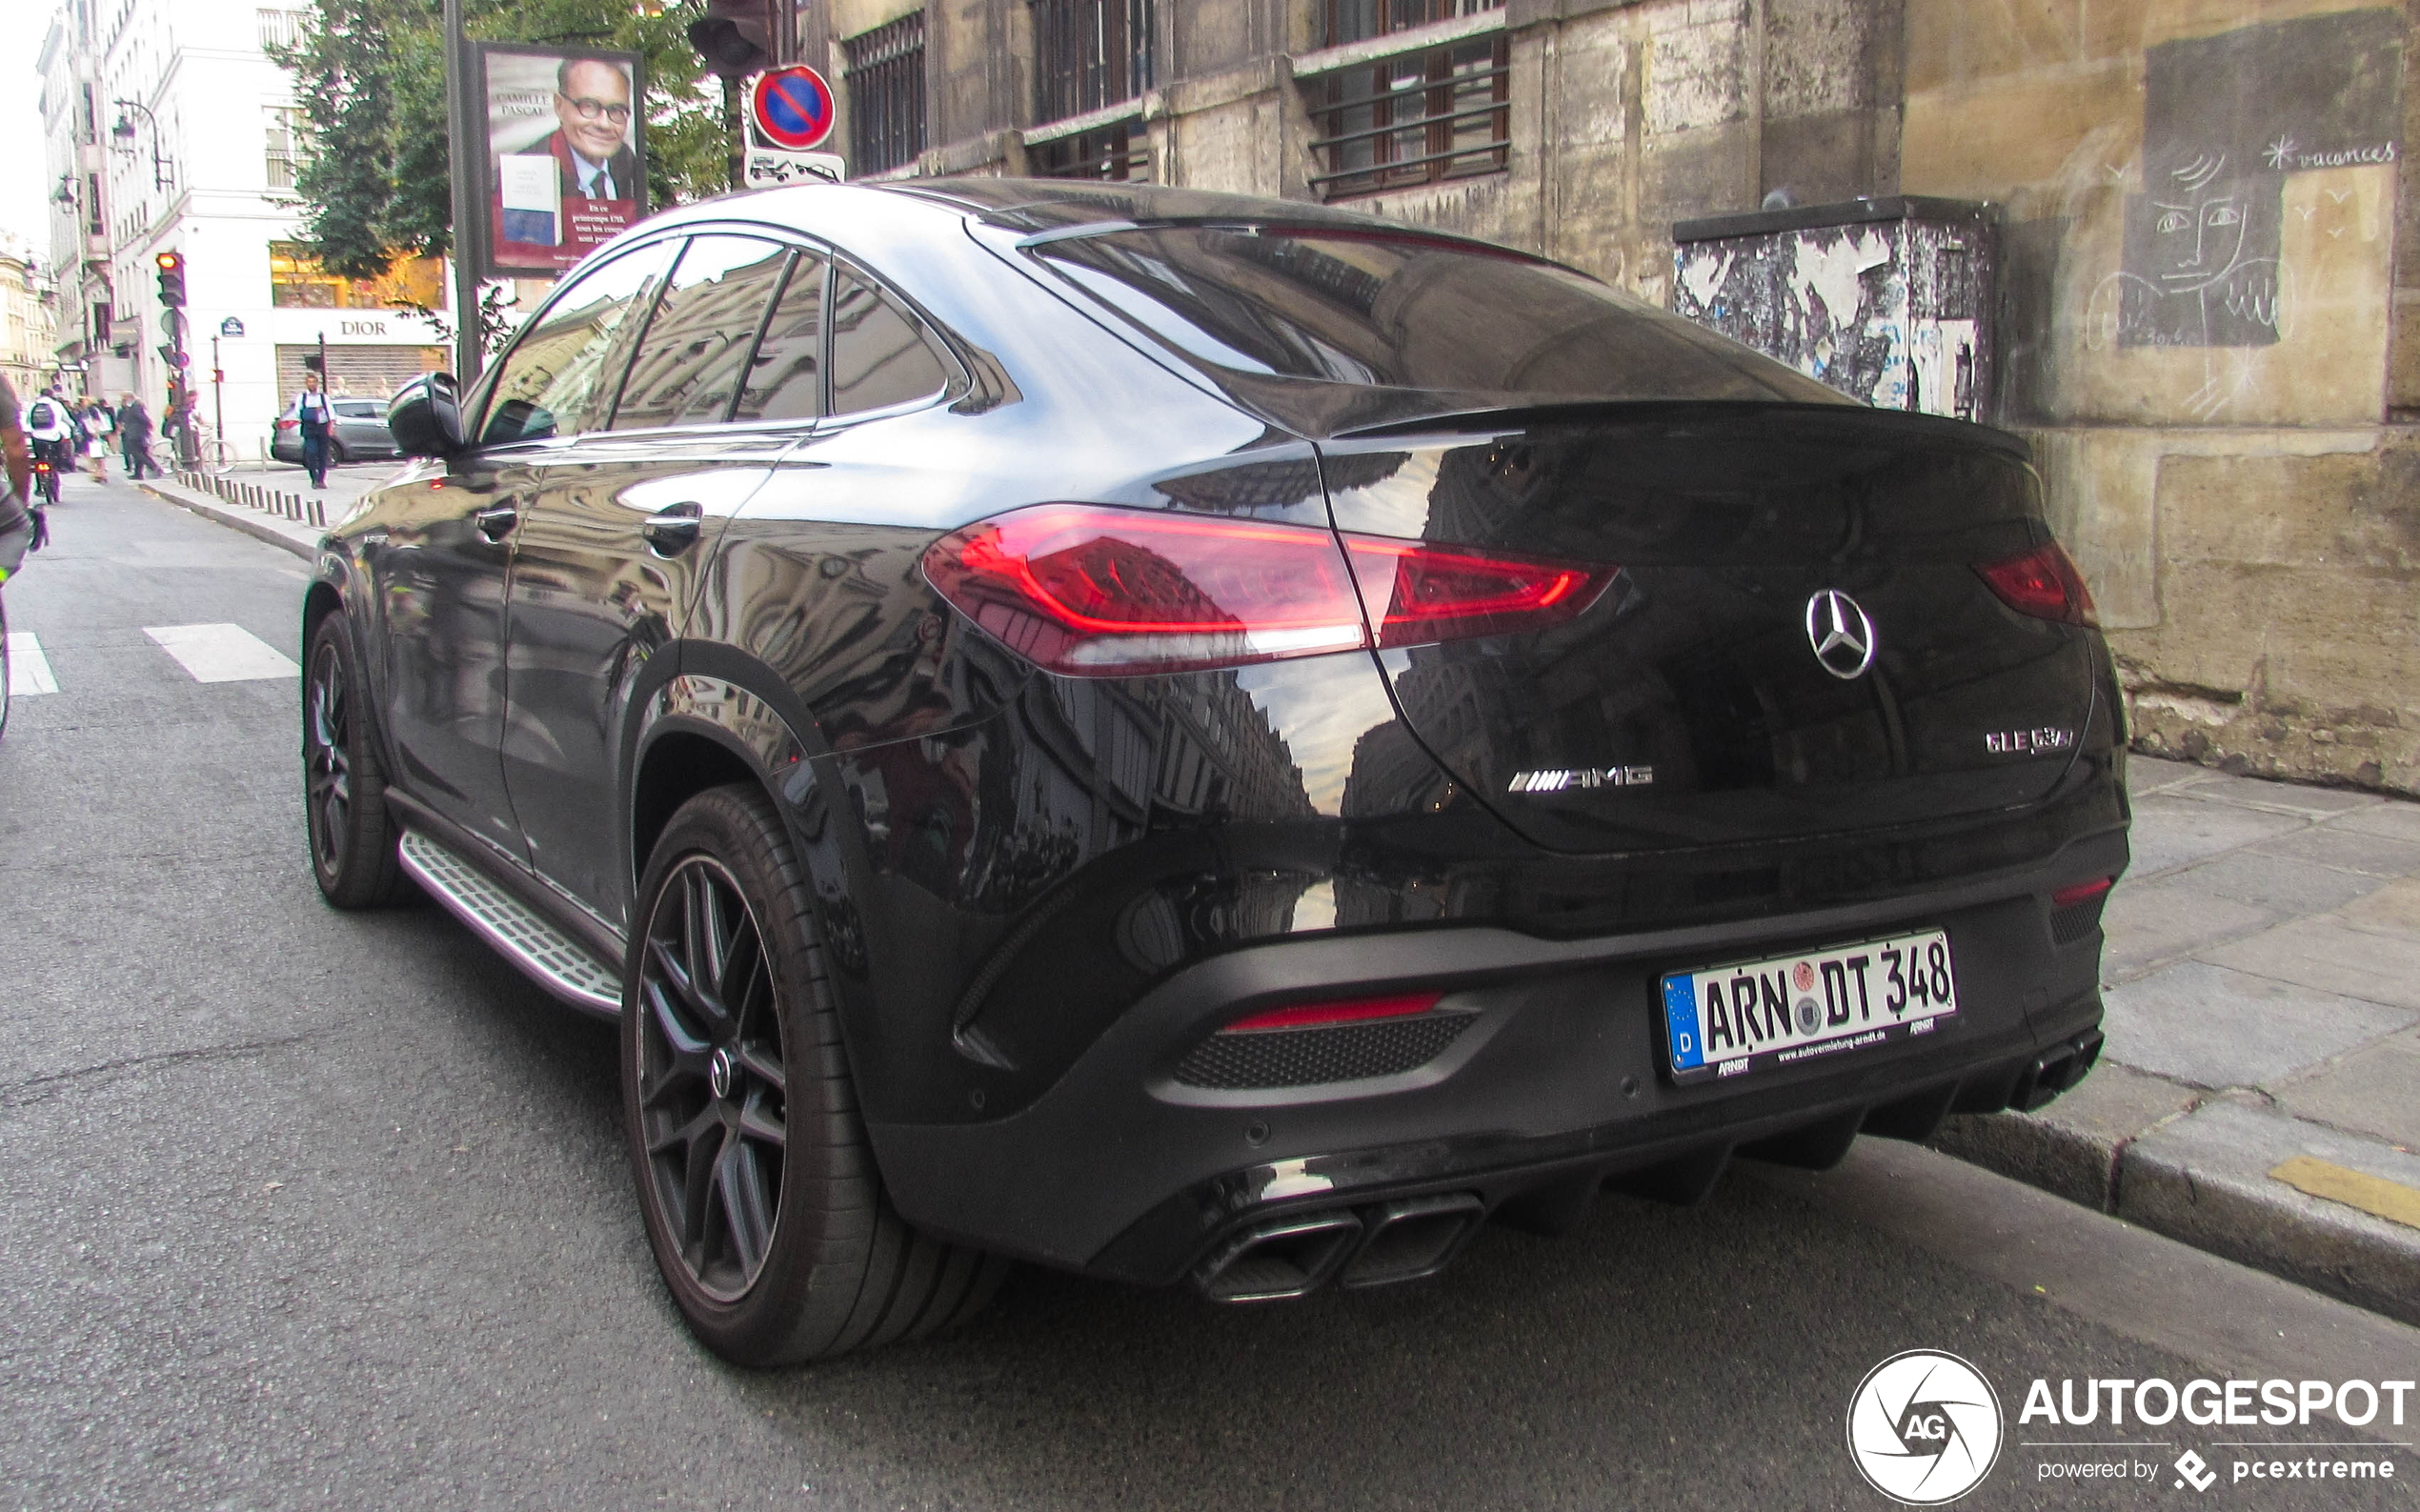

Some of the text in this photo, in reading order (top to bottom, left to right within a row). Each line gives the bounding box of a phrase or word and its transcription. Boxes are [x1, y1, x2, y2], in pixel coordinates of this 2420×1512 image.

[501, 105, 546, 116] PASCAL
[2297, 140, 2397, 169] vacances
[341, 321, 387, 335] DIOR
[1985, 729, 2027, 755] GLE
[1567, 765, 1653, 789] AMG
[1706, 942, 1950, 1051] ARN DT 348
[1909, 1018, 1935, 1034] ARNDT
[1679, 1033, 1692, 1053] D
[1778, 1031, 1886, 1062] www.autovermietung-arndt.de
[1718, 1058, 1749, 1076] ARNDT
